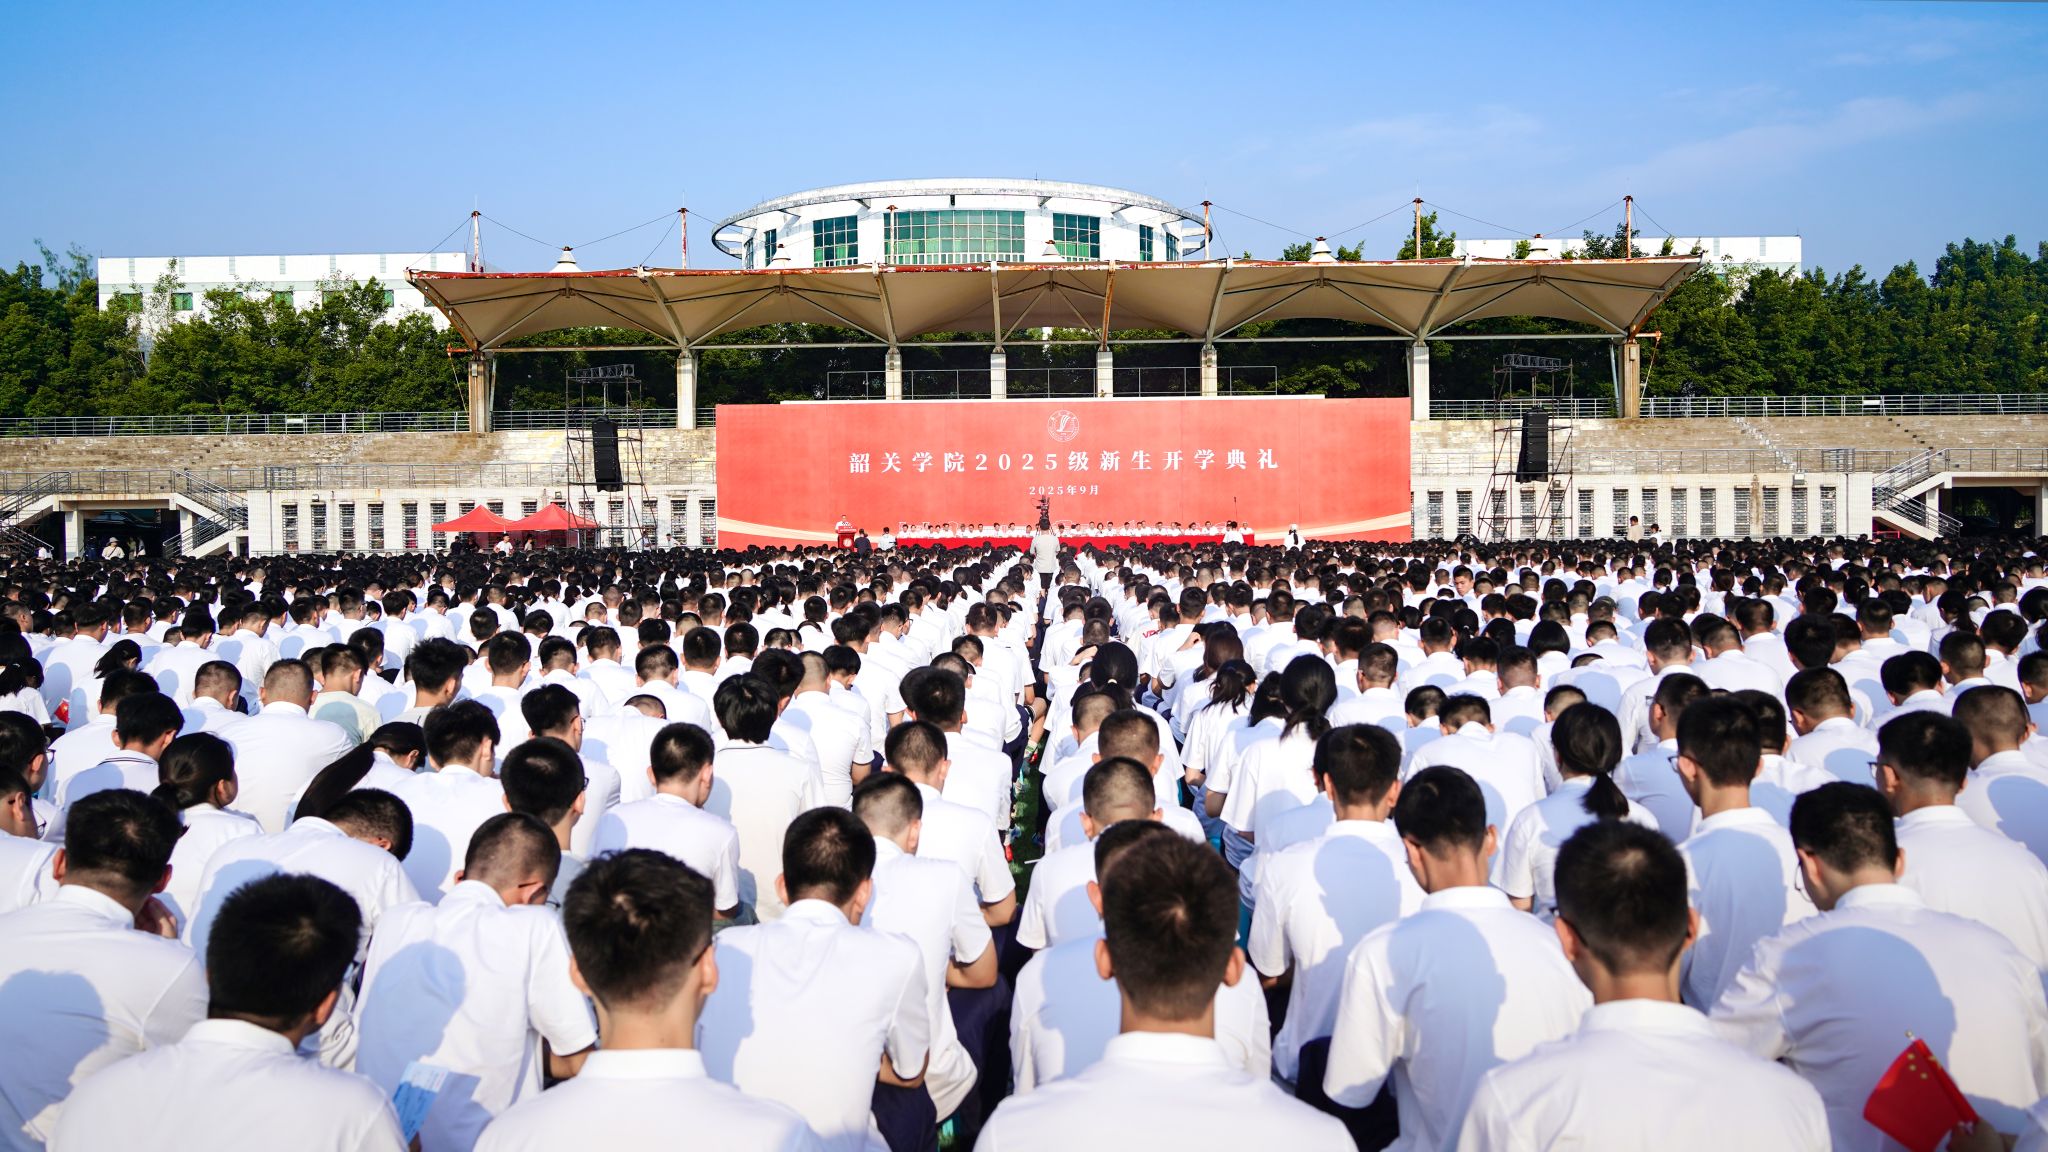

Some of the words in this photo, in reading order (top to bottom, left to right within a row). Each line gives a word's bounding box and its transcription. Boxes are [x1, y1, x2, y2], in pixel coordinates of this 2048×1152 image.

[849, 448, 1279, 474] 韶关学院2025级新生开学典礼
[1029, 484, 1099, 496] 2025年9月
